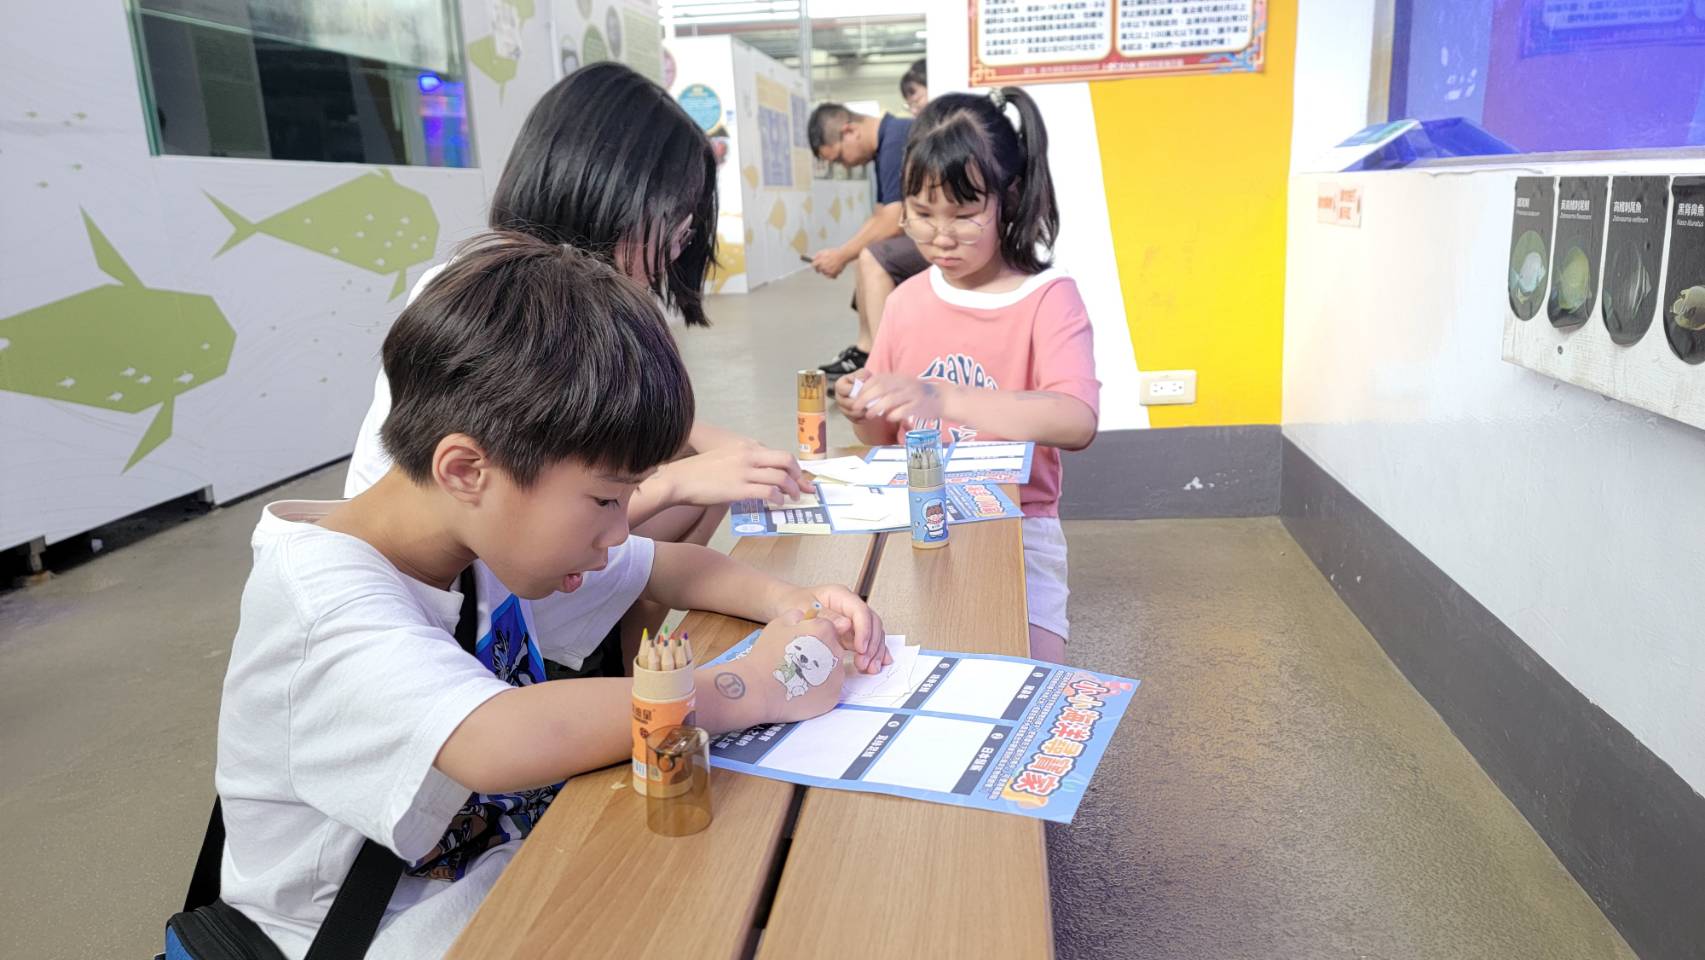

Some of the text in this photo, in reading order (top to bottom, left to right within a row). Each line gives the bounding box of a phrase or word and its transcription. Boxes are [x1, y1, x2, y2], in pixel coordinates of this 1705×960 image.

[1012, 680, 1109, 796] 小小海洋尋寶家
